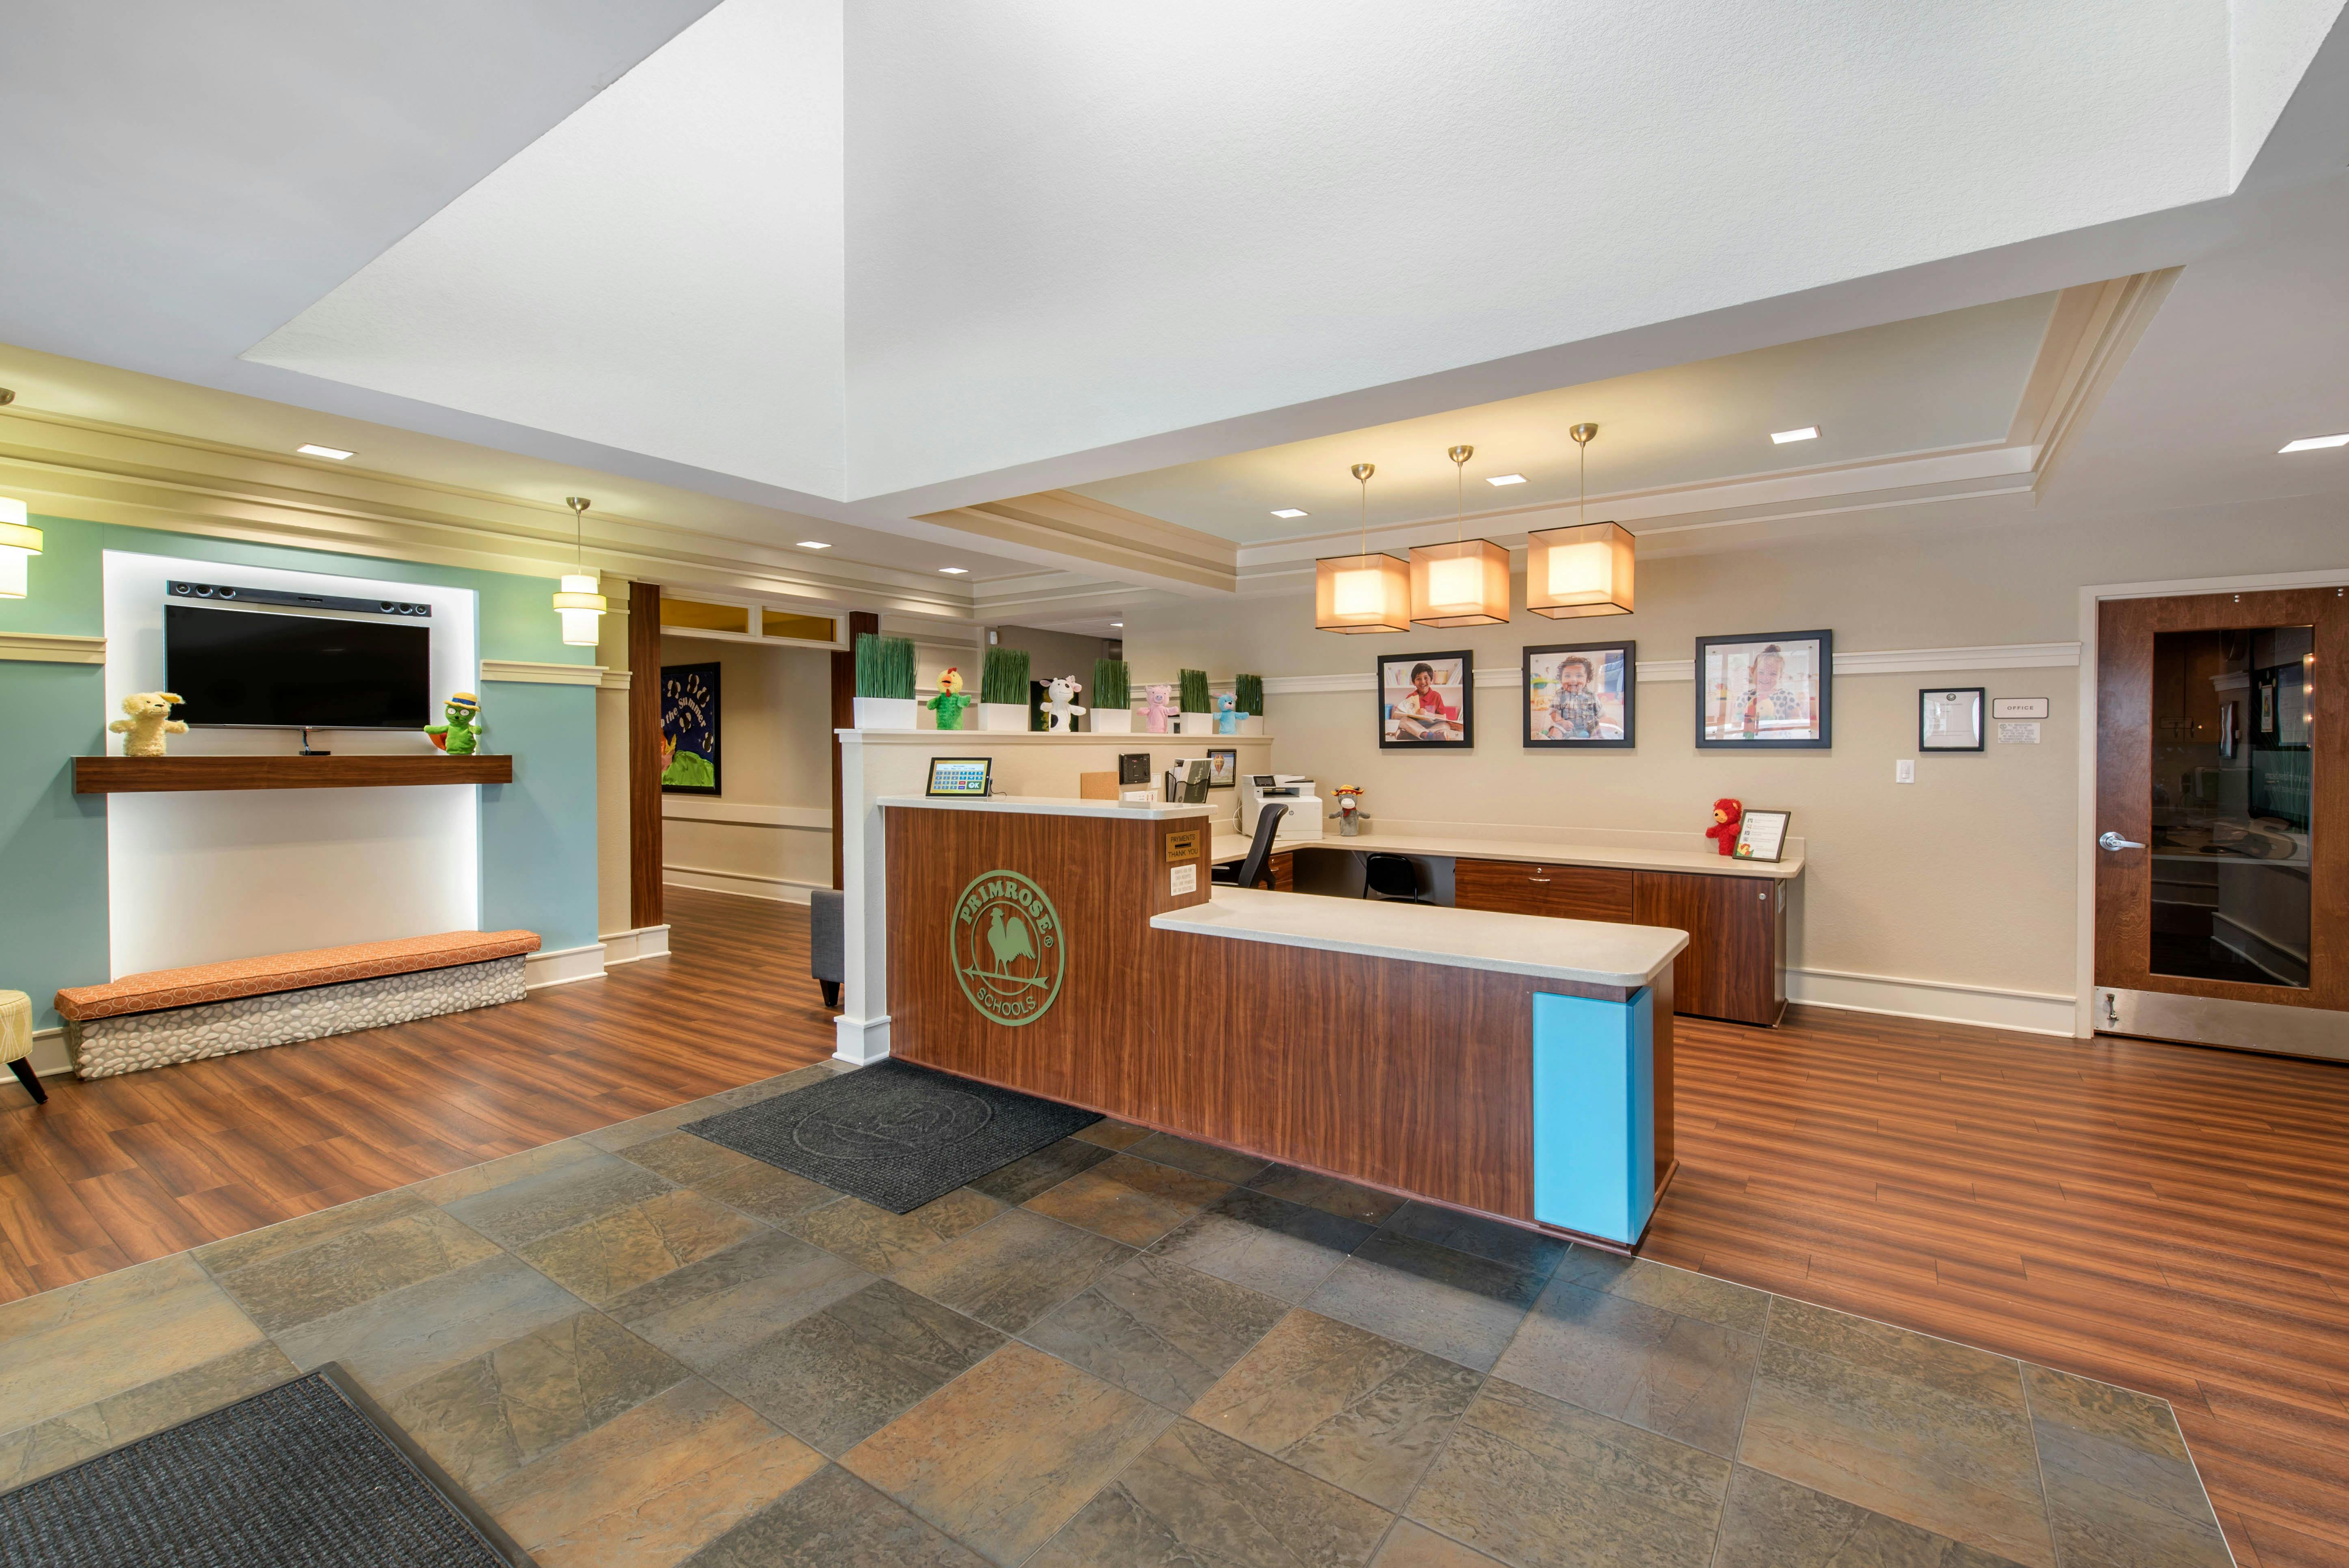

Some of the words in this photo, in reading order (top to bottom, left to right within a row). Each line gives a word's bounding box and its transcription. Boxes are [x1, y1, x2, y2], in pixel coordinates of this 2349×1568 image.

[661, 718, 665, 728] p
[666, 707, 678, 724] the
[678, 697, 706, 727] Summer
[1170, 834, 1196, 843] PAYMENTS
[1168, 850, 1186, 858] THANK
[977, 987, 1037, 1016] SCHOOLS
